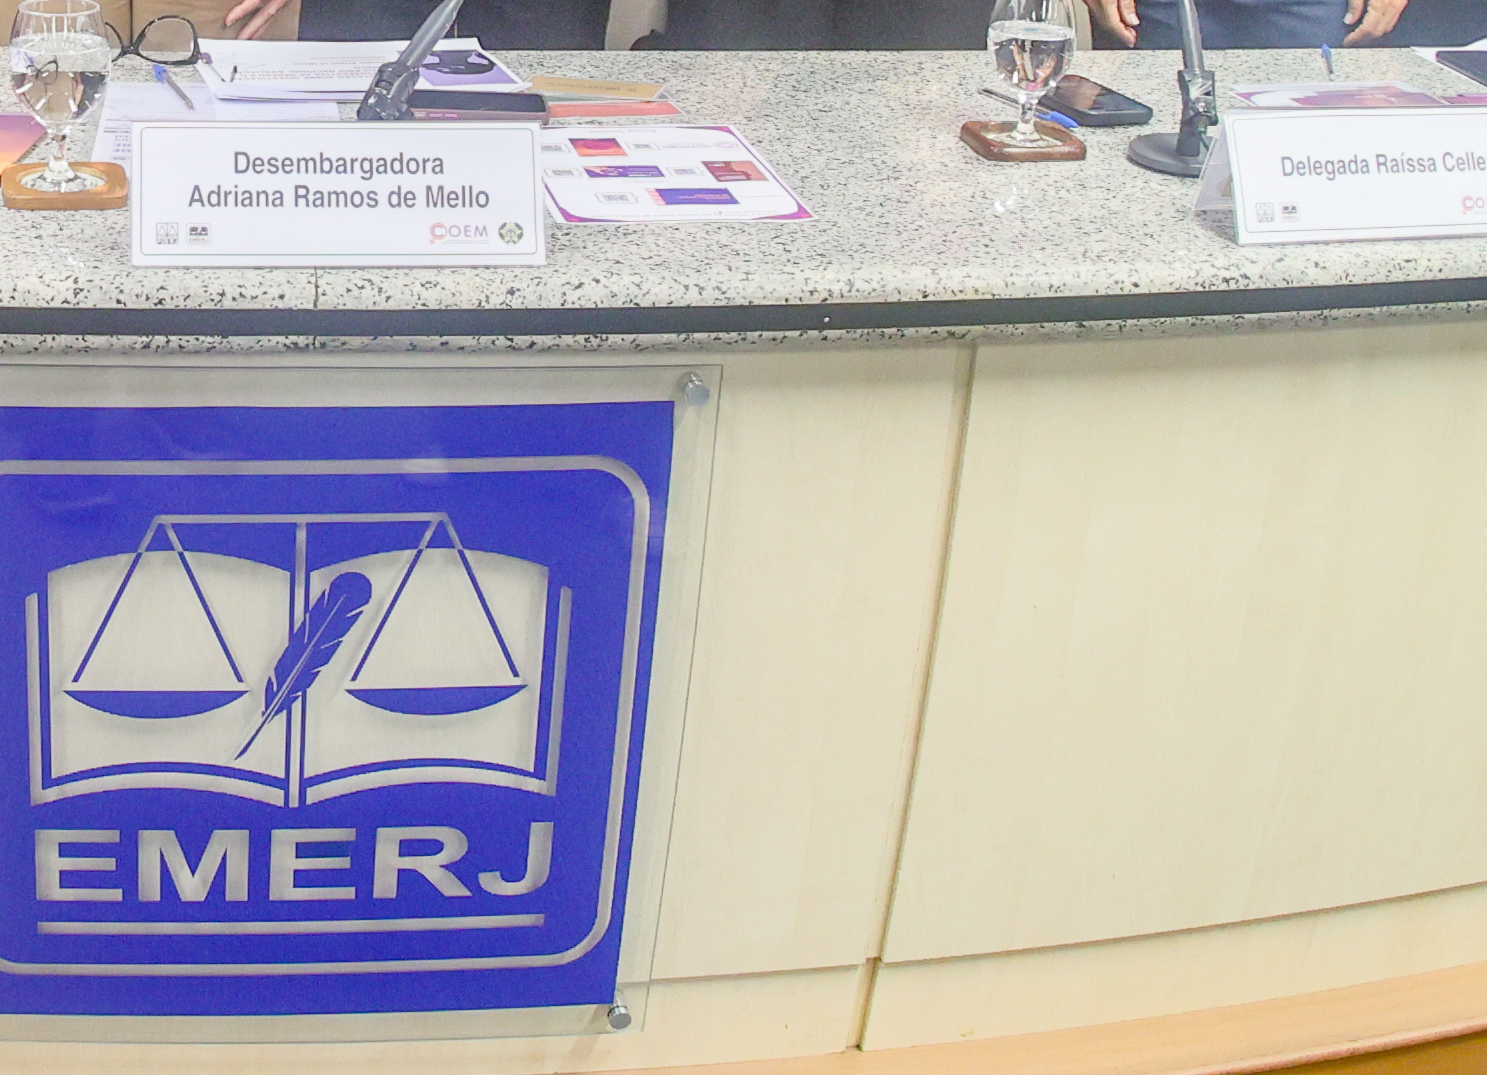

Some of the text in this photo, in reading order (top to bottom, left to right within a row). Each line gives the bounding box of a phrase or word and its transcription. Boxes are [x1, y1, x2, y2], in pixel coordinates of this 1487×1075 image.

[233, 151, 445, 181] Desembargadora
[1280, 154, 1370, 181] Delegada
[1376, 152, 1437, 175] Raíssa
[187, 184, 491, 209] Adriana Ramos de Mello
[1461, 195, 1487, 215] CO
[430, 222, 490, 245] COEM
[35, 822, 554, 902] EMERJ
